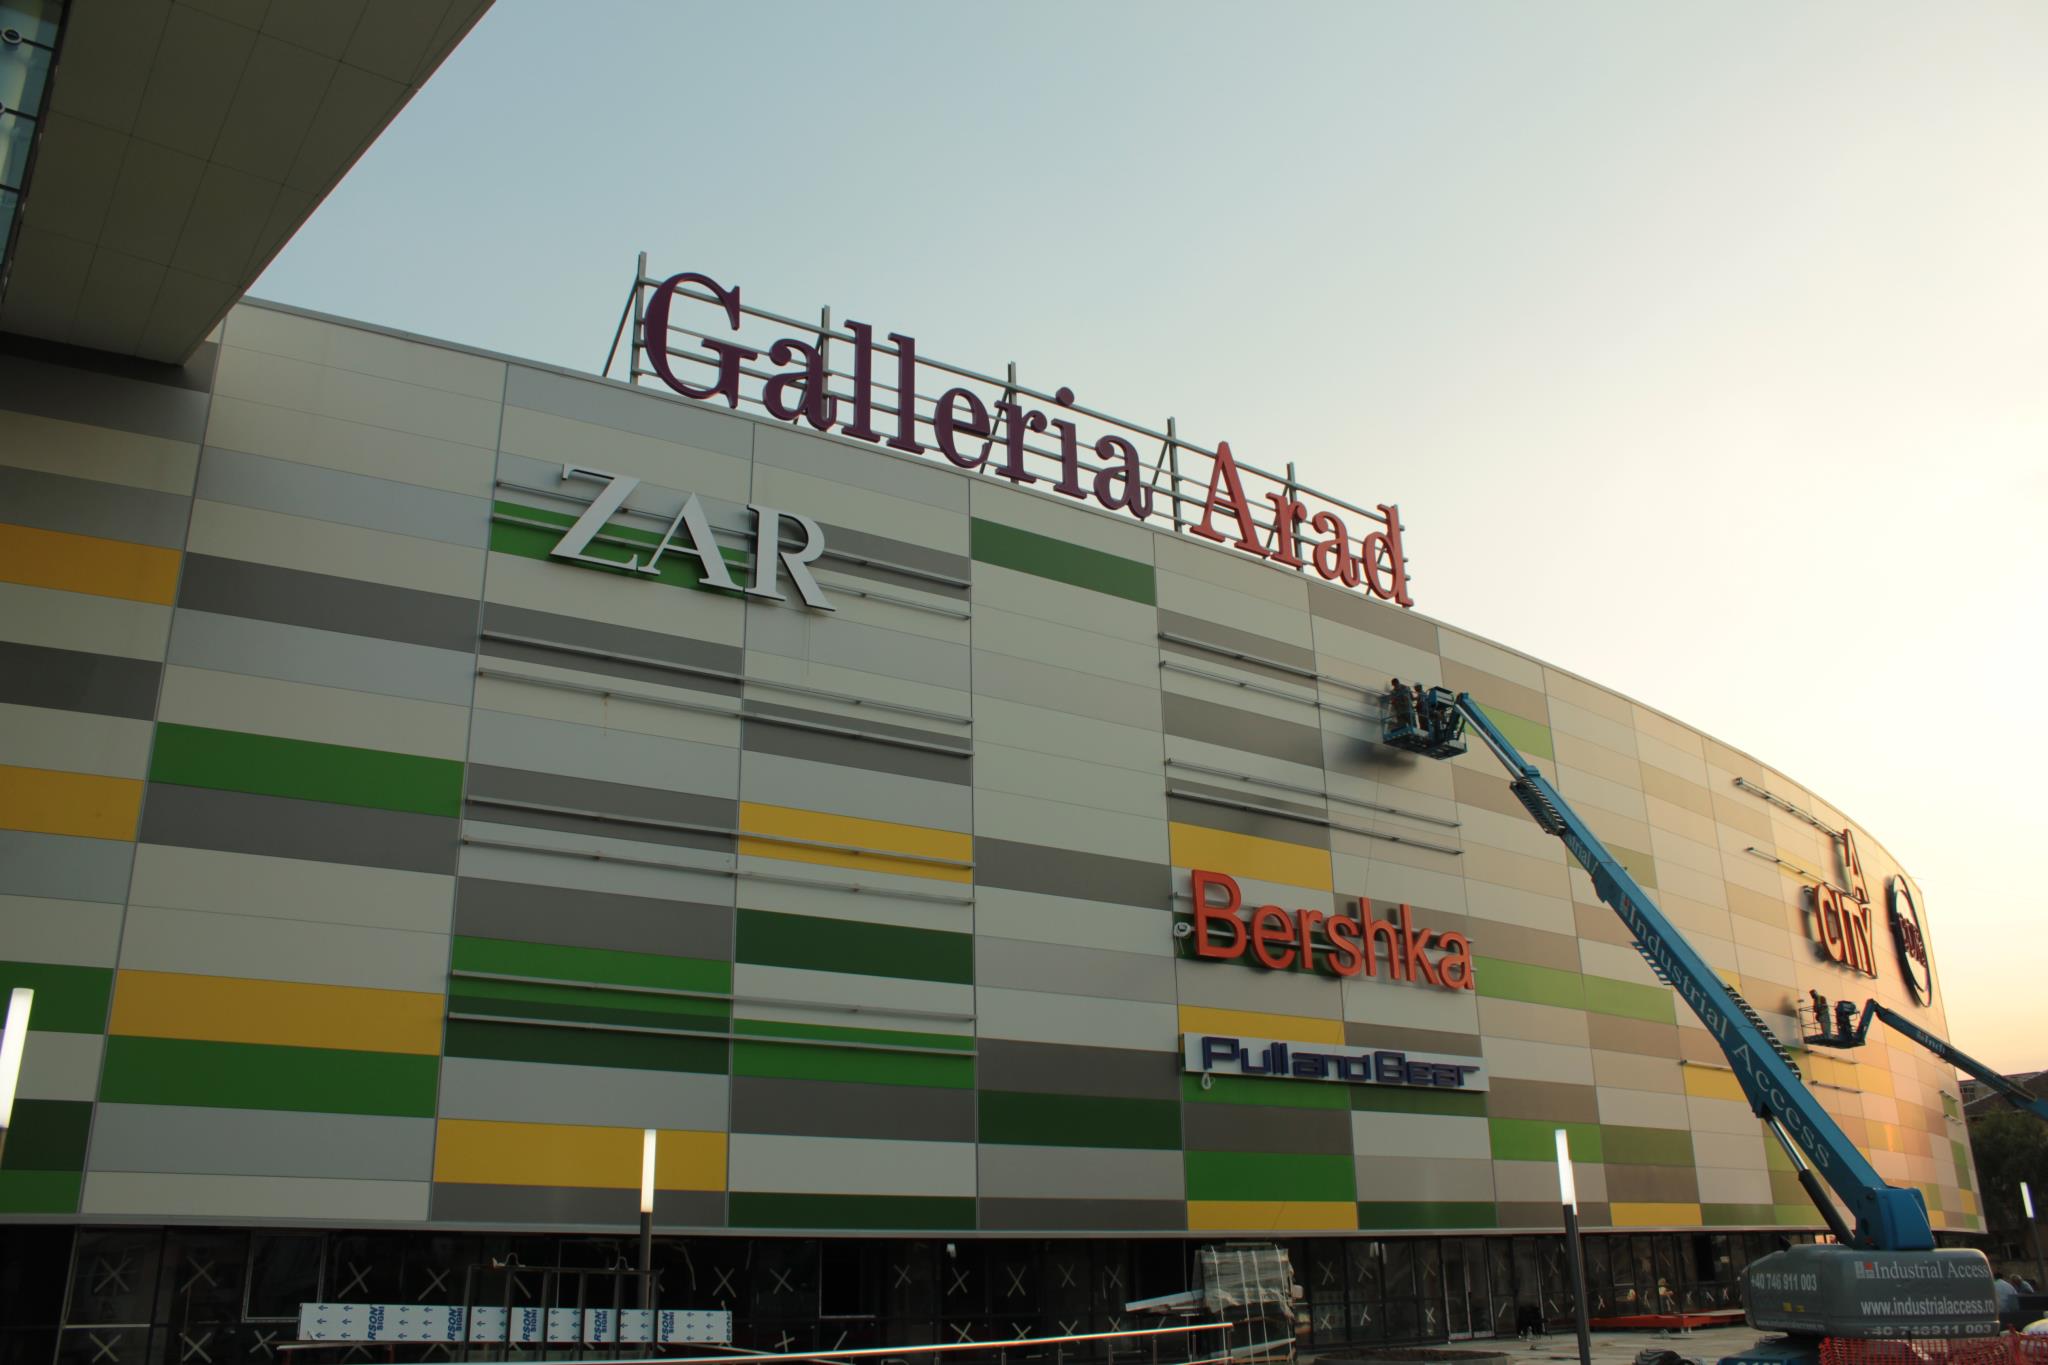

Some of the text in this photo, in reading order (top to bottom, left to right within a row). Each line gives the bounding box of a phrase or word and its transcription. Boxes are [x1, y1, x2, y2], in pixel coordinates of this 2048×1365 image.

[643, 271, 1414, 607] Galleria Arad
[550, 463, 836, 612] ZAR
[1191, 869, 1475, 990] Bershka
[1814, 882, 1877, 979] CITY
[1202, 1036, 1480, 1087] PullandBear
[1626, 905, 1829, 1168] Industrial Access
[1784, 1274, 1798, 1291] 911
[1801, 1274, 1817, 1291] 003
[1860, 1297, 1995, 1316] www.industrialaccess.ro
[1873, 1260, 1989, 1279] Industrial Access
[1965, 1324, 1992, 1334] 003
